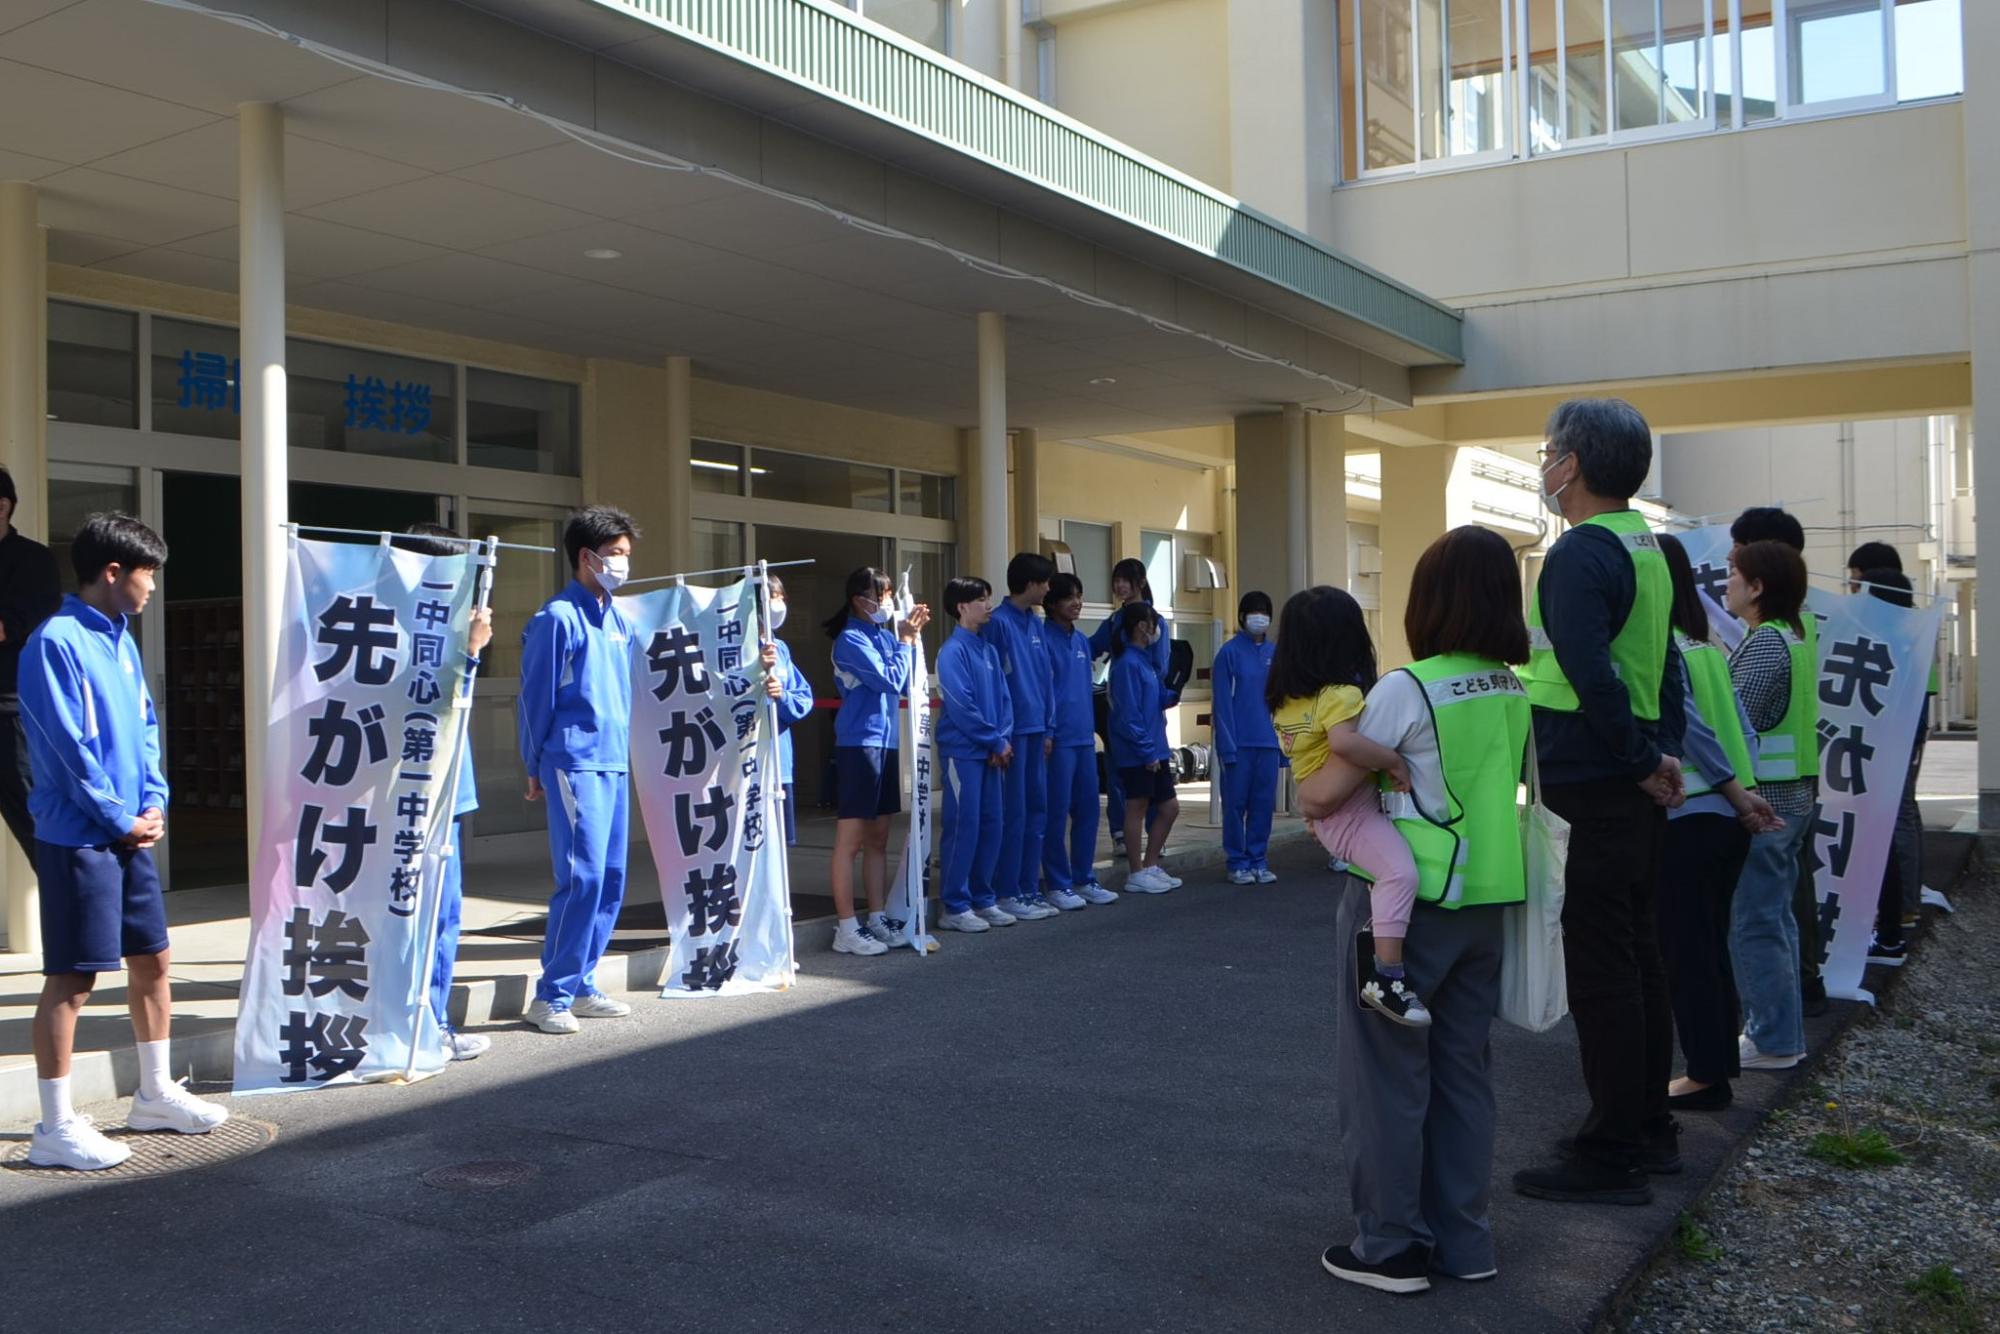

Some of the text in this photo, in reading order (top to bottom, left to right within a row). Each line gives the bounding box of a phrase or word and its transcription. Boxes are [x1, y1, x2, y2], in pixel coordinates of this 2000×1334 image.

[177, 350, 433, 434] 掃 挨拶
[279, 596, 398, 1083] 先がけ挨拶
[649, 627, 741, 991] 先がけ挨拶
